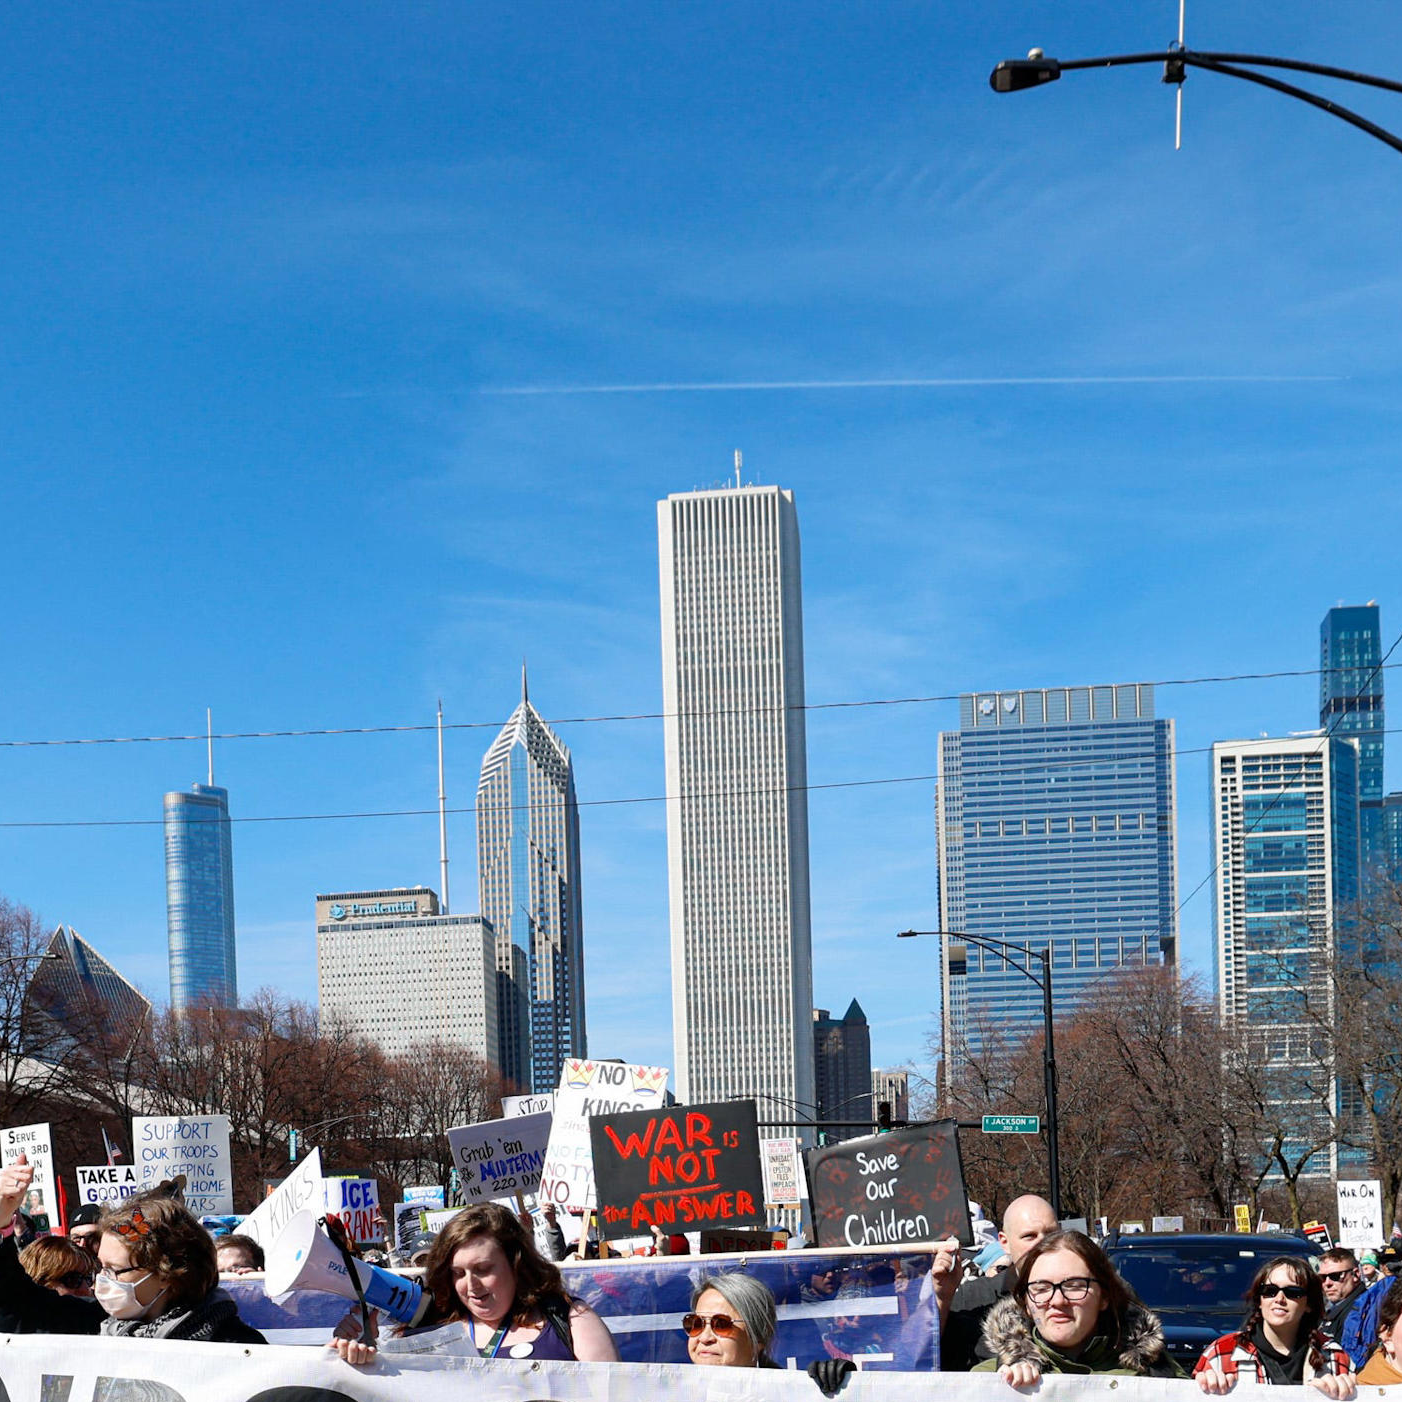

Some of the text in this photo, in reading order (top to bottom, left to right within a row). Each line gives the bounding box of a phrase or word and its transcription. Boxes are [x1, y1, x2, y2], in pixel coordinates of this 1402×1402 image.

[351, 900, 417, 914] Prudential
[597, 1064, 626, 1086] NO
[142, 1122, 213, 1141] SUPPORT
[991, 1118, 1027, 1126] JACKSON
[8, 1130, 37, 1145] SERVE
[603, 1111, 714, 1160] WAR
[722, 1130, 740, 1149] IS
[5, 1144, 49, 1158] YOUR 3RD
[141, 1144, 219, 1161] OUR TROOPS
[460, 1140, 494, 1164] Grab
[143, 1163, 215, 1178] BY KEEPING
[546, 1161, 567, 1178] NO
[648, 1148, 722, 1186] NOT
[856, 1152, 899, 1176] Save
[79, 1168, 136, 1184] TAKE A
[469, 1170, 543, 1197] IN 220 DAY
[191, 1179, 226, 1193] HOME
[340, 1179, 375, 1209] ICE
[540, 1178, 570, 1204] NO
[1339, 1186, 1357, 1198] WAR
[269, 1165, 314, 1239] KINGS
[600, 1204, 631, 1224] the
[630, 1190, 756, 1230] ANSWER
[844, 1208, 930, 1248] Children
[1341, 1216, 1358, 1229] NOT
